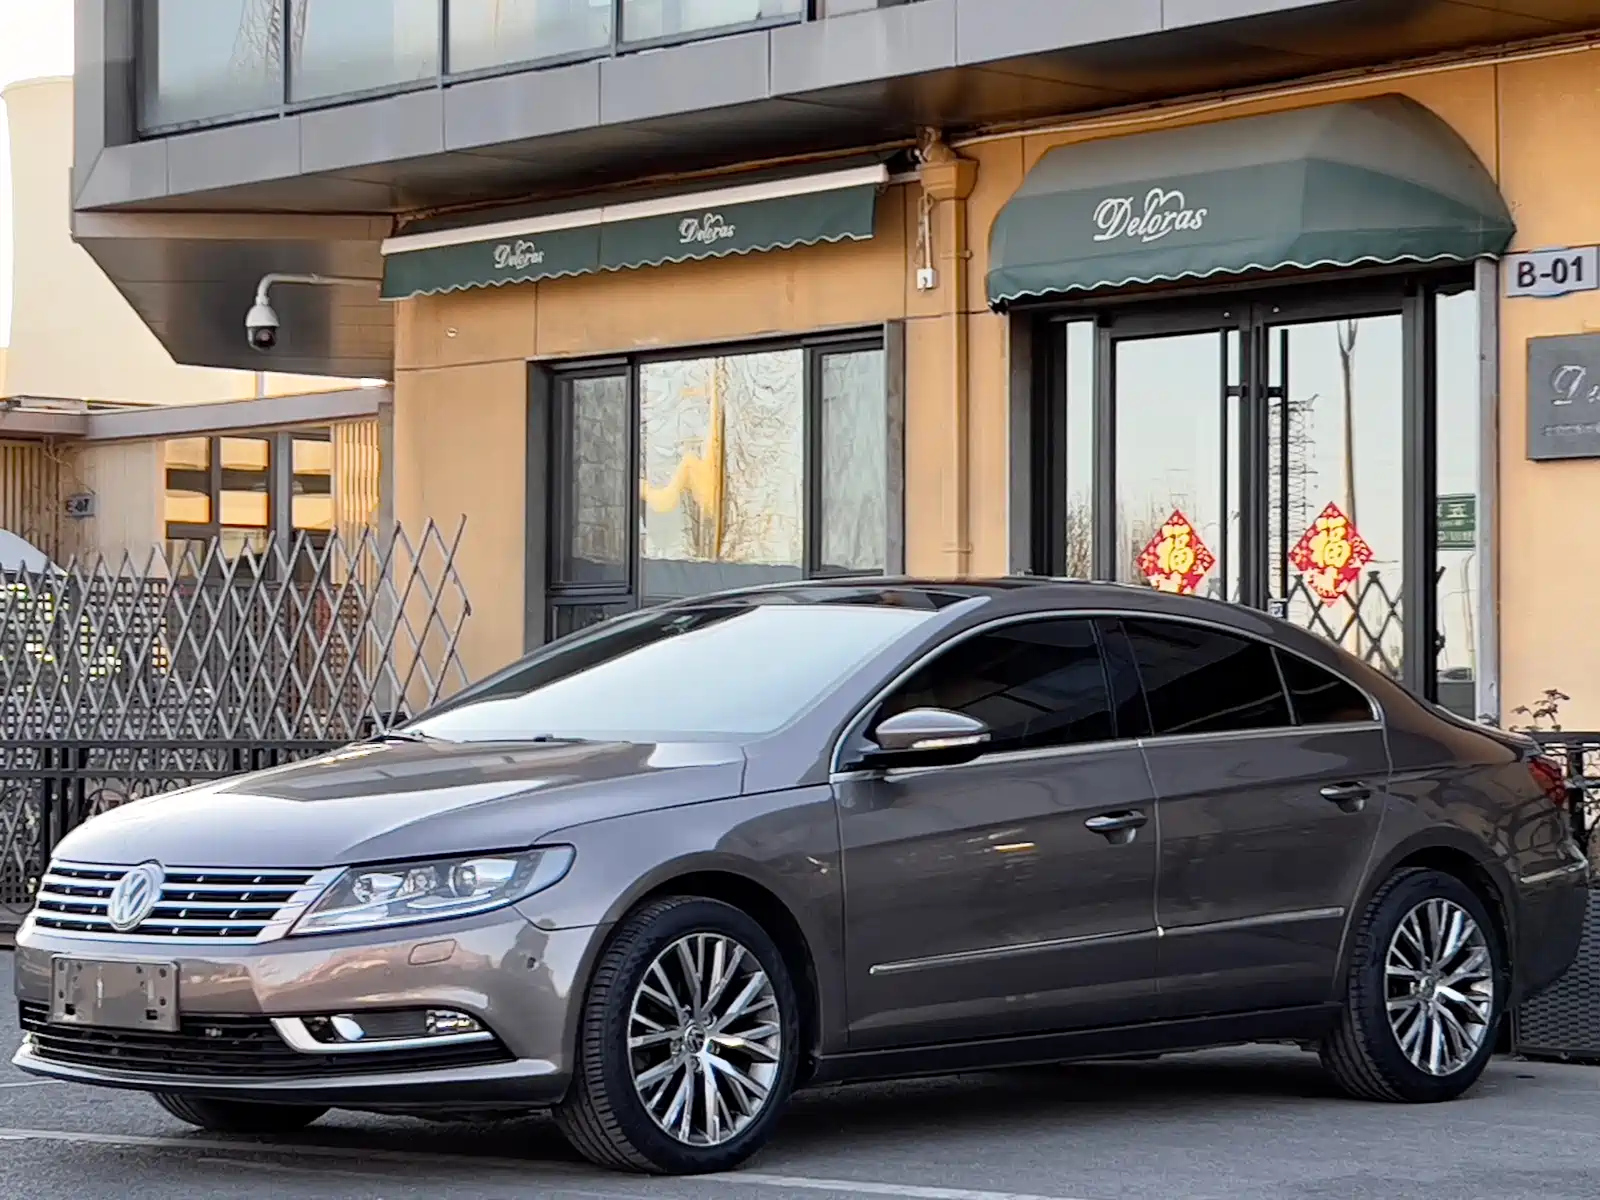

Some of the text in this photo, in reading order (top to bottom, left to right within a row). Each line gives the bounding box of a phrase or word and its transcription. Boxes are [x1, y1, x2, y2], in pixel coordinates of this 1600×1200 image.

[1093, 187, 1207, 243] Deloras
[1518, 256, 1583, 288] B-01
[1155, 523, 1196, 575] 福
[1307, 516, 1352, 568] 福
